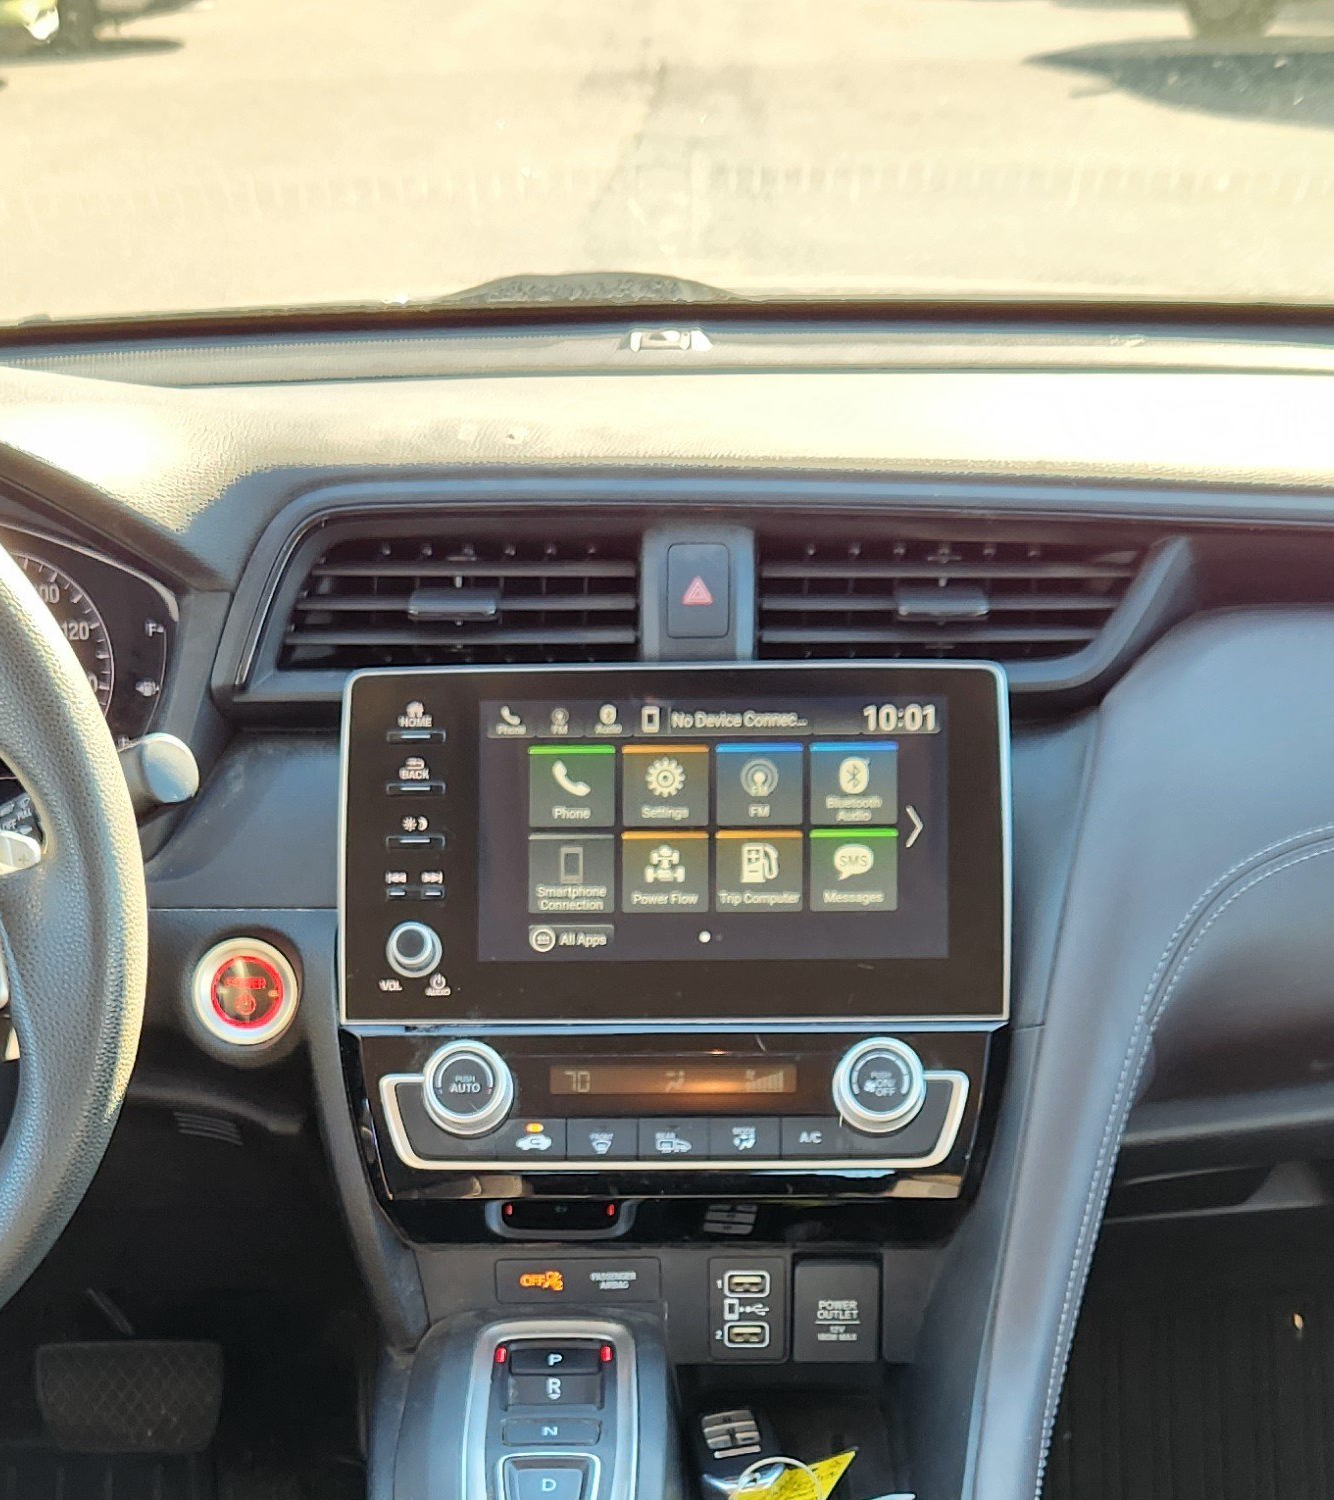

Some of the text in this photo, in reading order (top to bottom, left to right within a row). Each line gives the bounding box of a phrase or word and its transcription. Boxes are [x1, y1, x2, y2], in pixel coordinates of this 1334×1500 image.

[62, 623, 89, 641] 120
[398, 716, 432, 728] HOME
[671, 711, 693, 728] No
[694, 711, 742, 728] Device
[863, 704, 936, 732] 10:01
[496, 725, 526, 735] Phone
[399, 768, 429, 780] BACK
[826, 795, 882, 810] Bluetooth
[552, 806, 591, 820] Phone
[642, 806, 689, 821] Settings
[749, 804, 770, 818] FM
[837, 810, 872, 822] Audio
[839, 855, 868, 867] SMS
[536, 884, 607, 900] Smartphone
[632, 891, 699, 905] Power Flow
[718, 889, 800, 906] Trip Computer
[823, 890, 884, 905] Messages
[539, 899, 604, 911] Connection
[559, 931, 607, 948] All Apps
[379, 979, 402, 992] VOL
[564, 1070, 591, 1093] 70
[449, 1083, 481, 1094] AUTO
[875, 1088, 895, 1097] OFF
[799, 1131, 823, 1144] A/C
[818, 1300, 858, 1310] POWER
[817, 1310, 859, 1320] OUTLET
[548, 1353, 563, 1366] P
[547, 1377, 561, 1394] R
[542, 1426, 558, 1436] N
[542, 1478, 557, 1491] D
